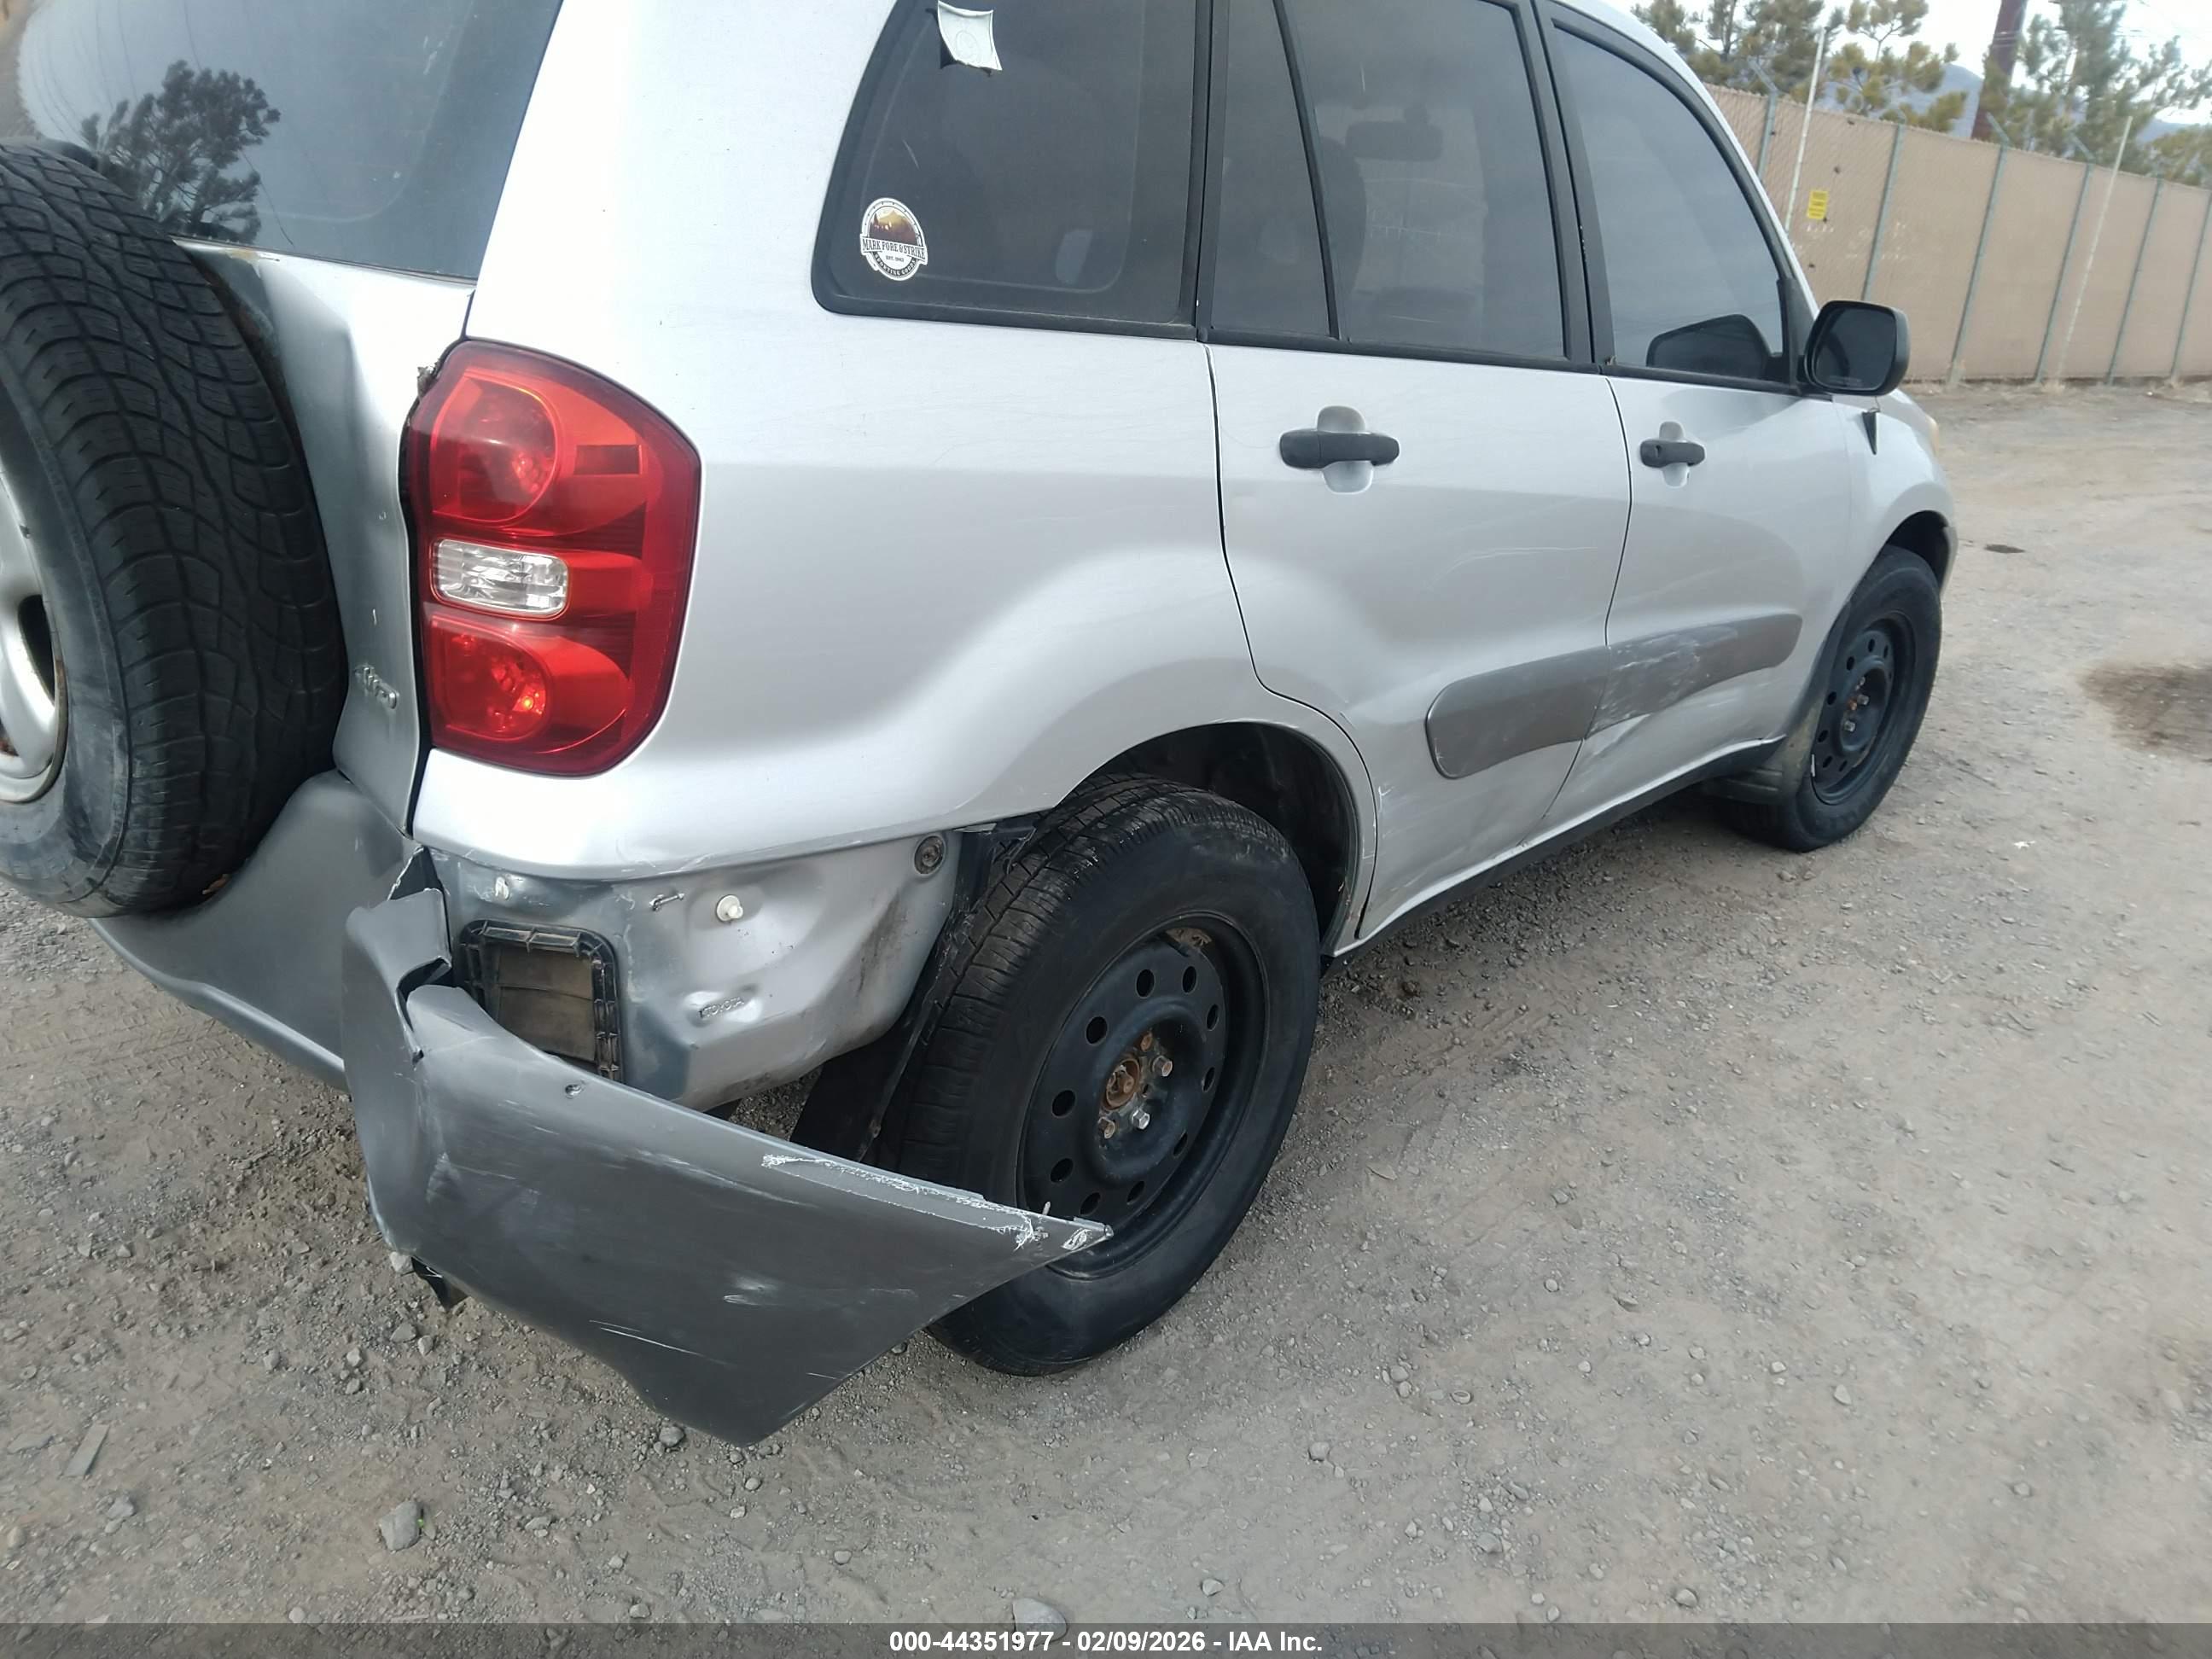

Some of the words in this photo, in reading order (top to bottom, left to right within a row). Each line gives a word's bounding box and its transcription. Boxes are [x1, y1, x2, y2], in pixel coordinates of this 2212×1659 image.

[862, 239, 881, 251] MARK
[882, 241, 898, 253] FORE
[904, 244, 926, 260] STRIKE
[701, 997, 744, 1018] TOYOTA
